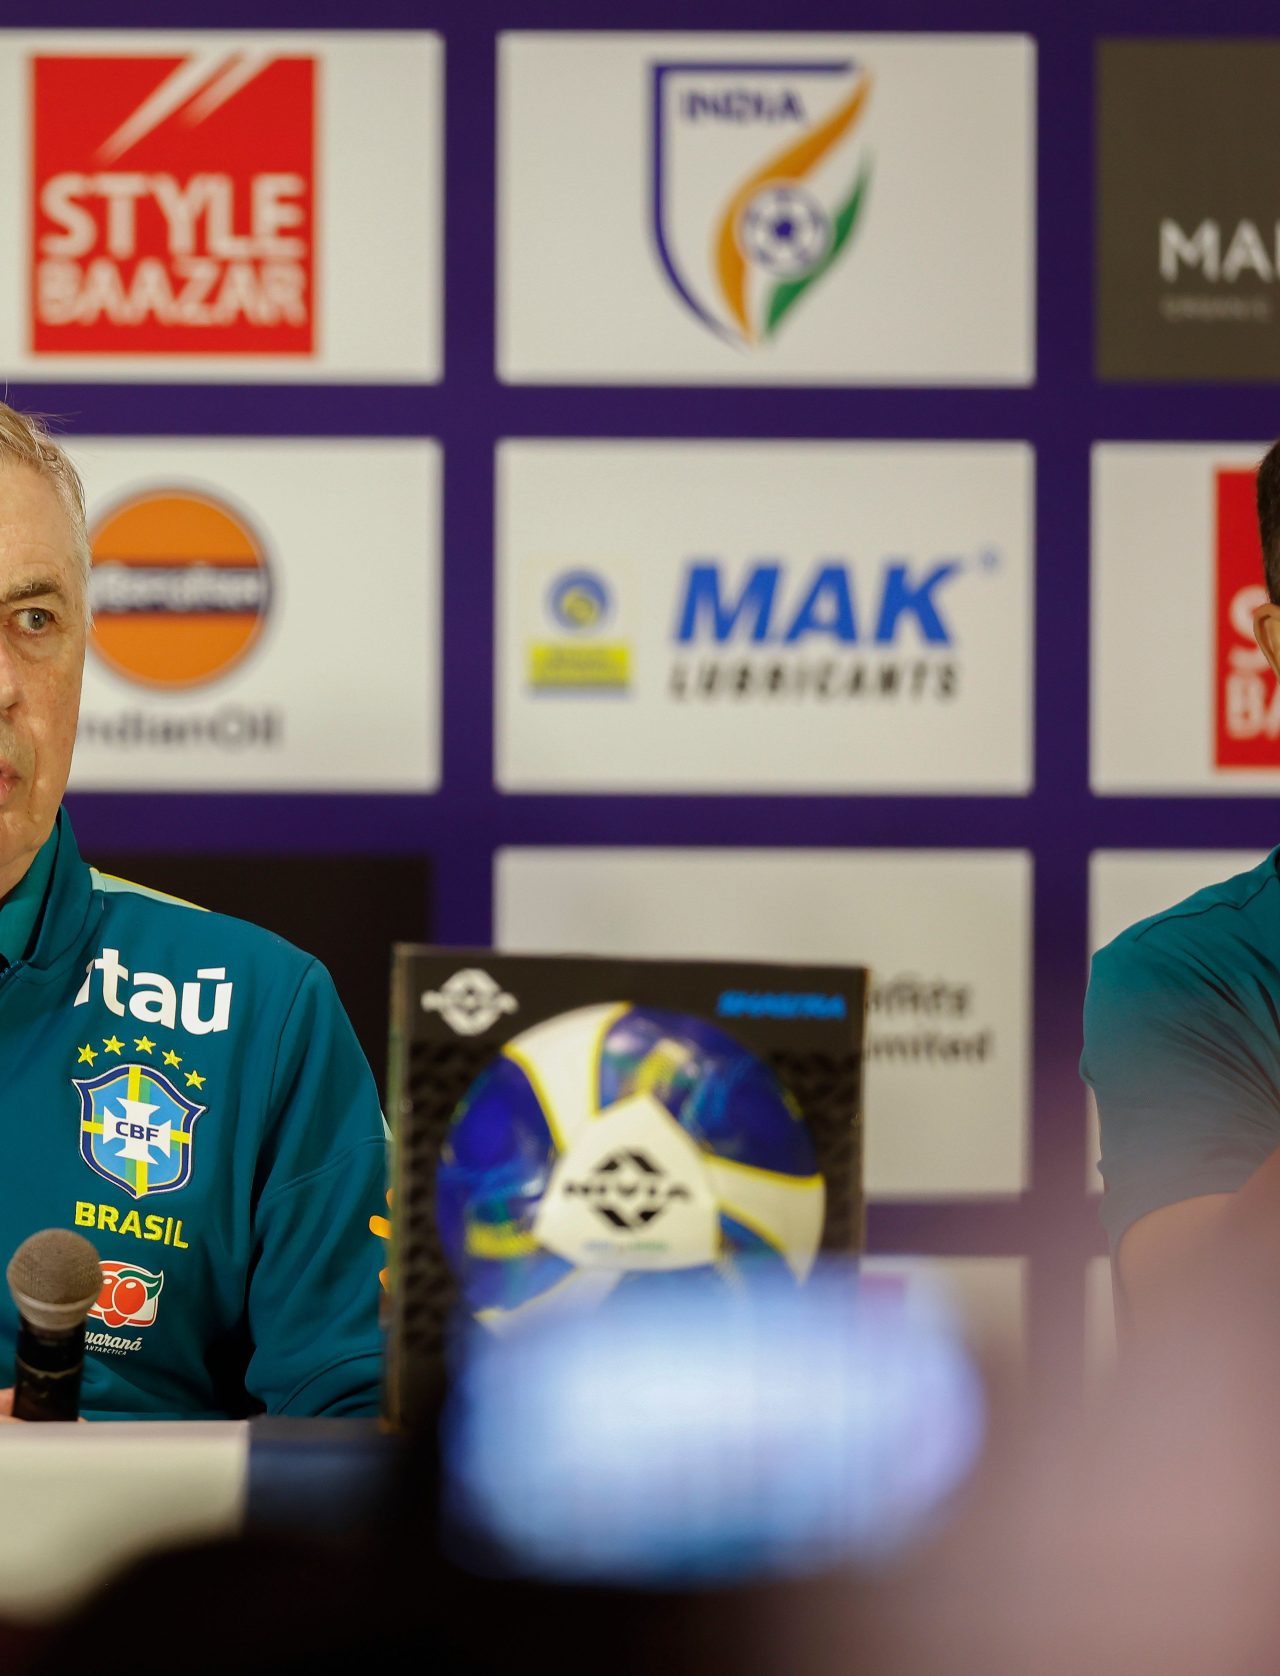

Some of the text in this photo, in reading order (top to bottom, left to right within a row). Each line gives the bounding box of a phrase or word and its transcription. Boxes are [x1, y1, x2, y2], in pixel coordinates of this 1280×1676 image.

[683, 88, 805, 122] INDIA
[39, 172, 306, 258] STYLE
[1160, 219, 1280, 281] MA
[37, 255, 307, 326] BAAZAR
[673, 560, 961, 648] MAK
[671, 659, 958, 700] LUBRICANTS
[78, 706, 283, 747] ndianOil
[115, 1121, 160, 1142] CBF
[74, 1200, 189, 1249] BRASIL
[84, 1331, 143, 1351] uaraná
[84, 1344, 127, 1356] ANTARCTICA
